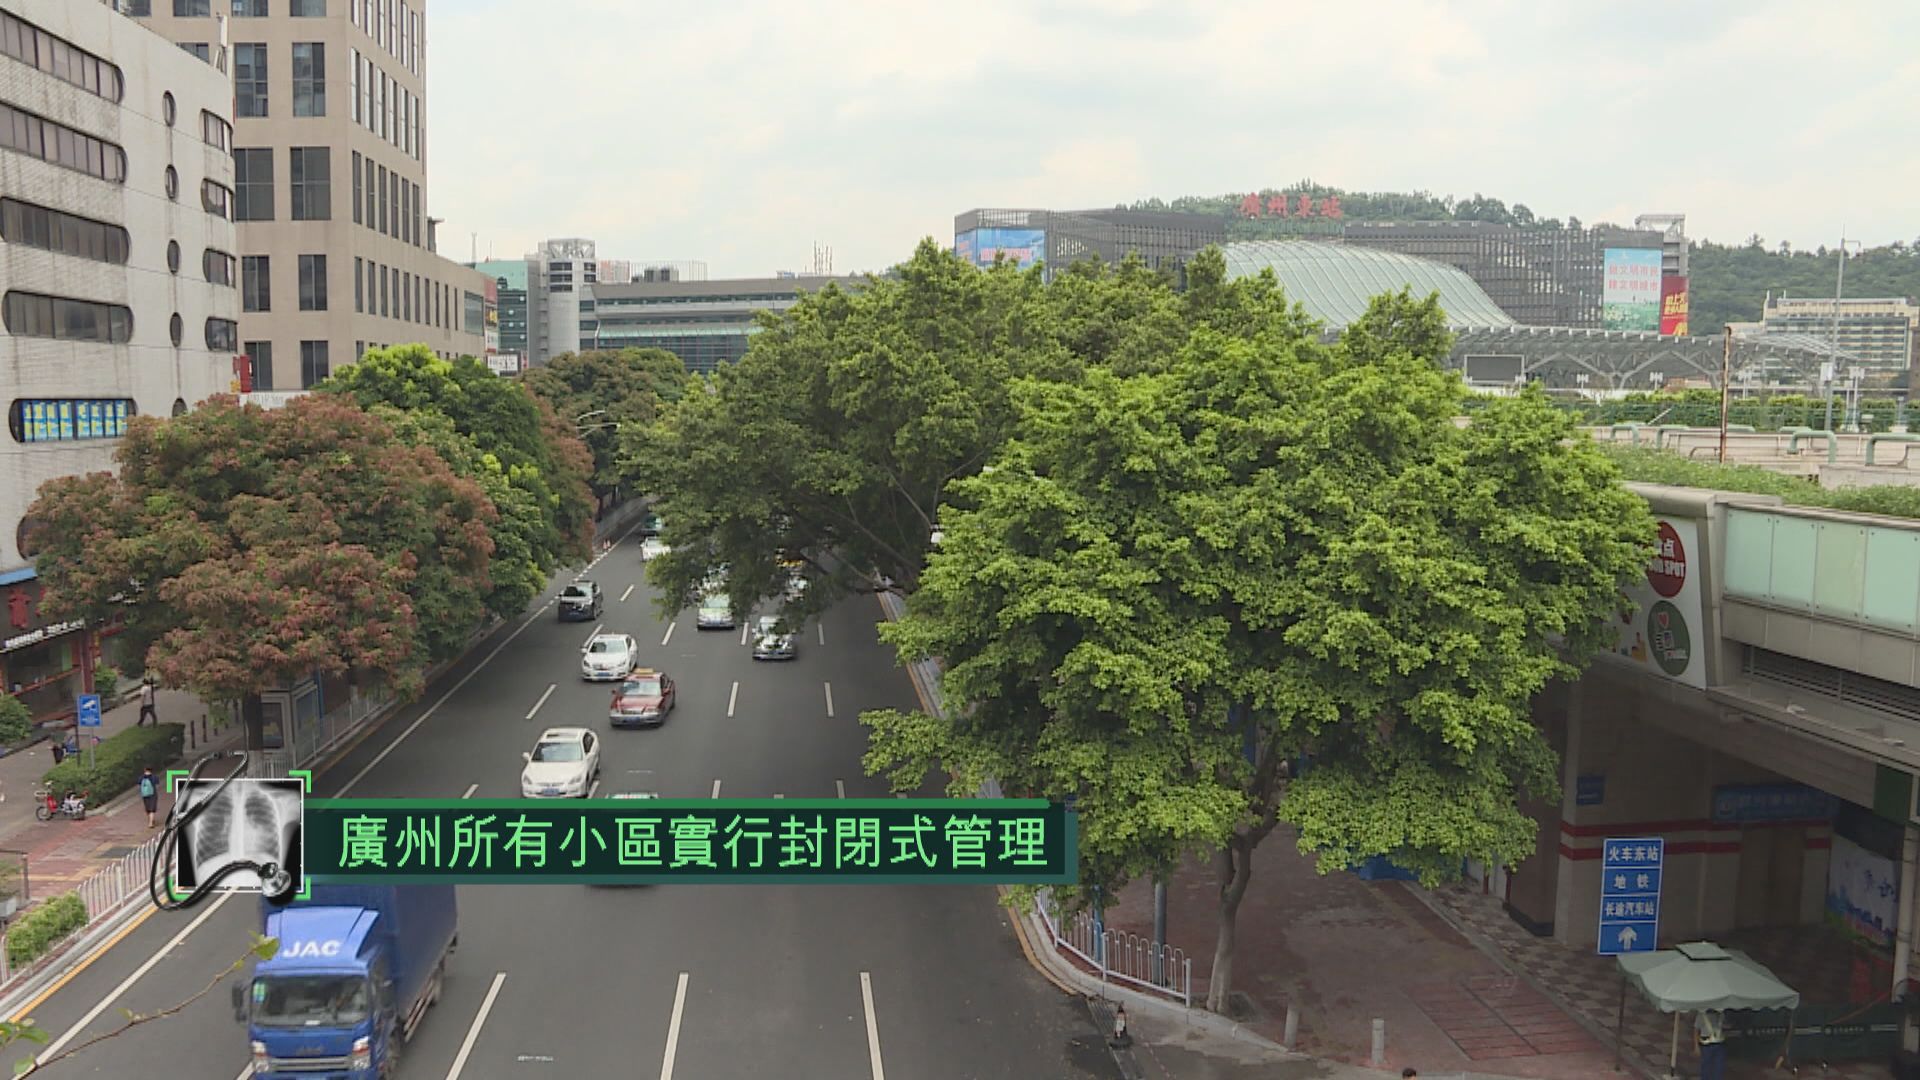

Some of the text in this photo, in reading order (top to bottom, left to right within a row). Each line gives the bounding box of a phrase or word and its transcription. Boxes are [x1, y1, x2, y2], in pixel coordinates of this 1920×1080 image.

[1664, 560, 1685, 578] SPOT
[1608, 845, 1659, 862] 火车东站
[1605, 901, 1655, 917] 长途汽车站
[282, 939, 342, 958] JAC
